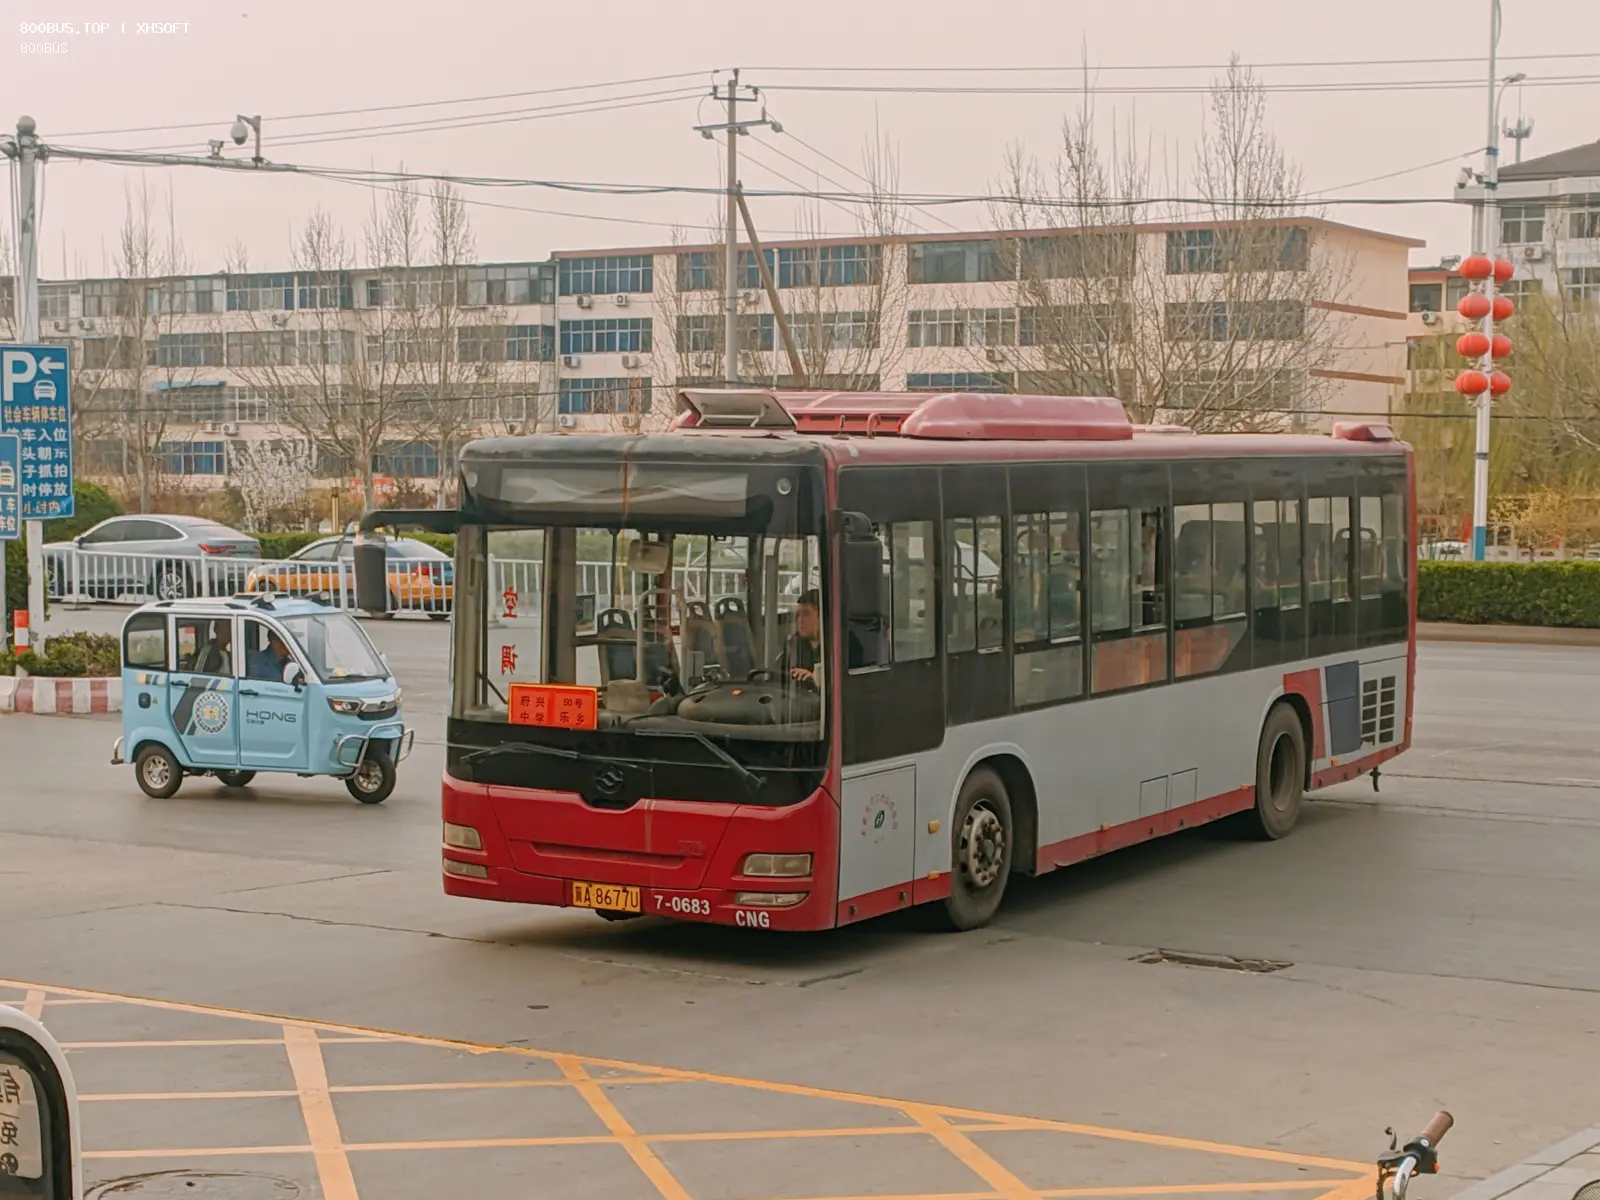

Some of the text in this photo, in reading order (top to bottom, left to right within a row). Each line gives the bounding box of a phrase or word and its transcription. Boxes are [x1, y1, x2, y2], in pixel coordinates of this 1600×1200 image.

[3, 351, 37, 401] P
[246, 709, 297, 724] HONG
[654, 894, 710, 915] 7-0683
[735, 909, 770, 928] CNG
